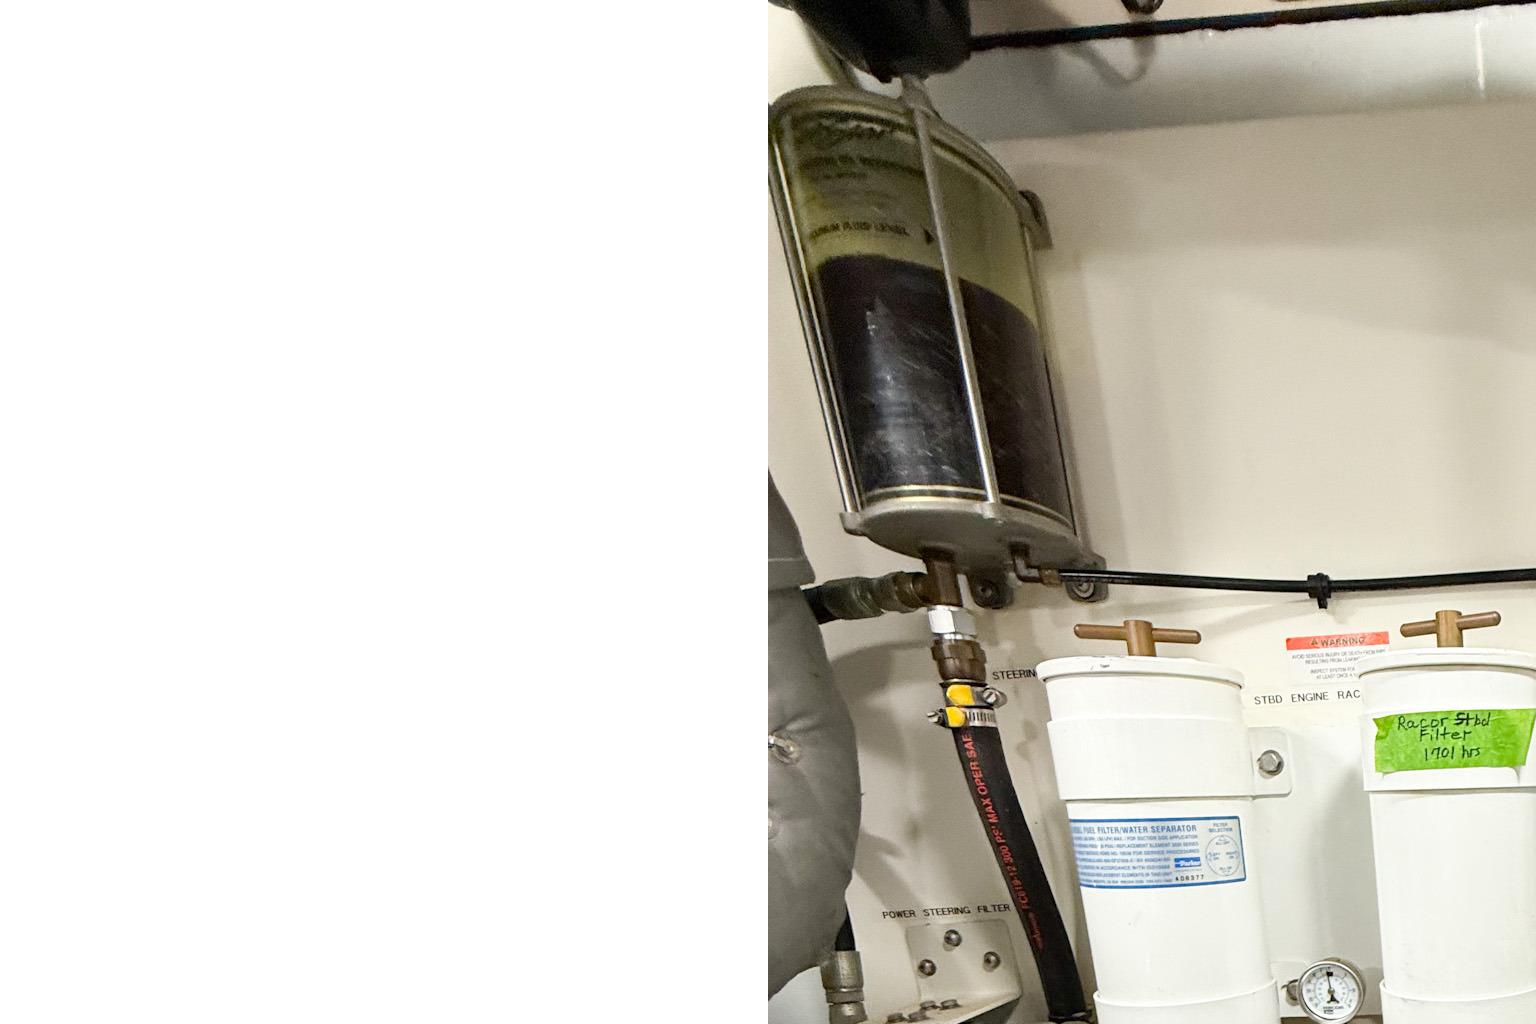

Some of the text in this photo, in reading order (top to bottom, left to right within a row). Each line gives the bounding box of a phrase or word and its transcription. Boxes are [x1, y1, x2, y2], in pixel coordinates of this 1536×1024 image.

[1321, 636, 1366, 647] WARNING
[992, 669, 1037, 680] STEERIN
[1254, 689, 1361, 705] STBD ENGINE RAC
[1397, 716, 1449, 731] Racor
[1419, 727, 1473, 742] Filter
[1460, 745, 1481, 759] hrs
[970, 761, 989, 796] OPER
[982, 798, 1000, 824] MAX
[1097, 825, 1149, 834] FILTER/WATER
[1150, 824, 1197, 833] SEPARATOR
[882, 903, 1011, 919] POWER STEERING FILTER
